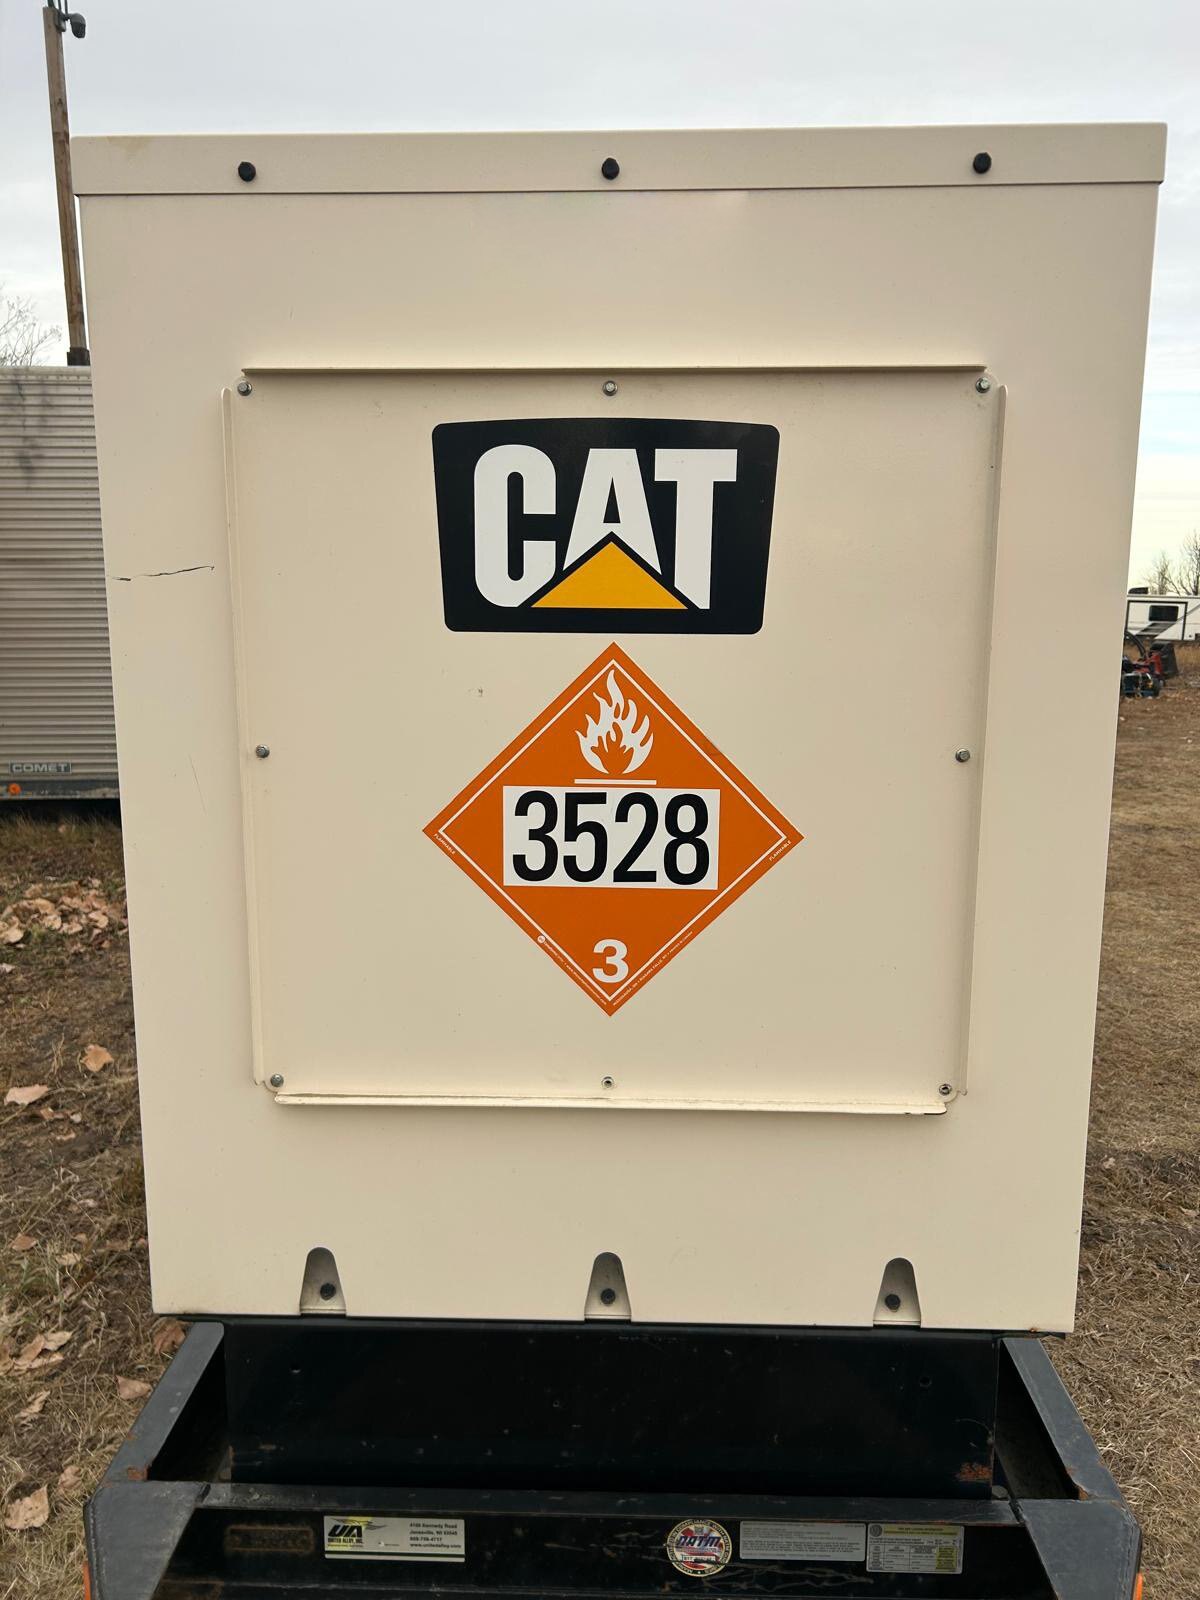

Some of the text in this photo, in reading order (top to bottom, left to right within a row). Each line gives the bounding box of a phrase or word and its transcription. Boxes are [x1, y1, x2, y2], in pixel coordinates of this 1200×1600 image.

[474, 444, 738, 610] CAT
[11, 763, 68, 773] COMET
[512, 790, 710, 886] 3528
[592, 938, 630, 984] 3
[328, 1524, 363, 1538] UA
